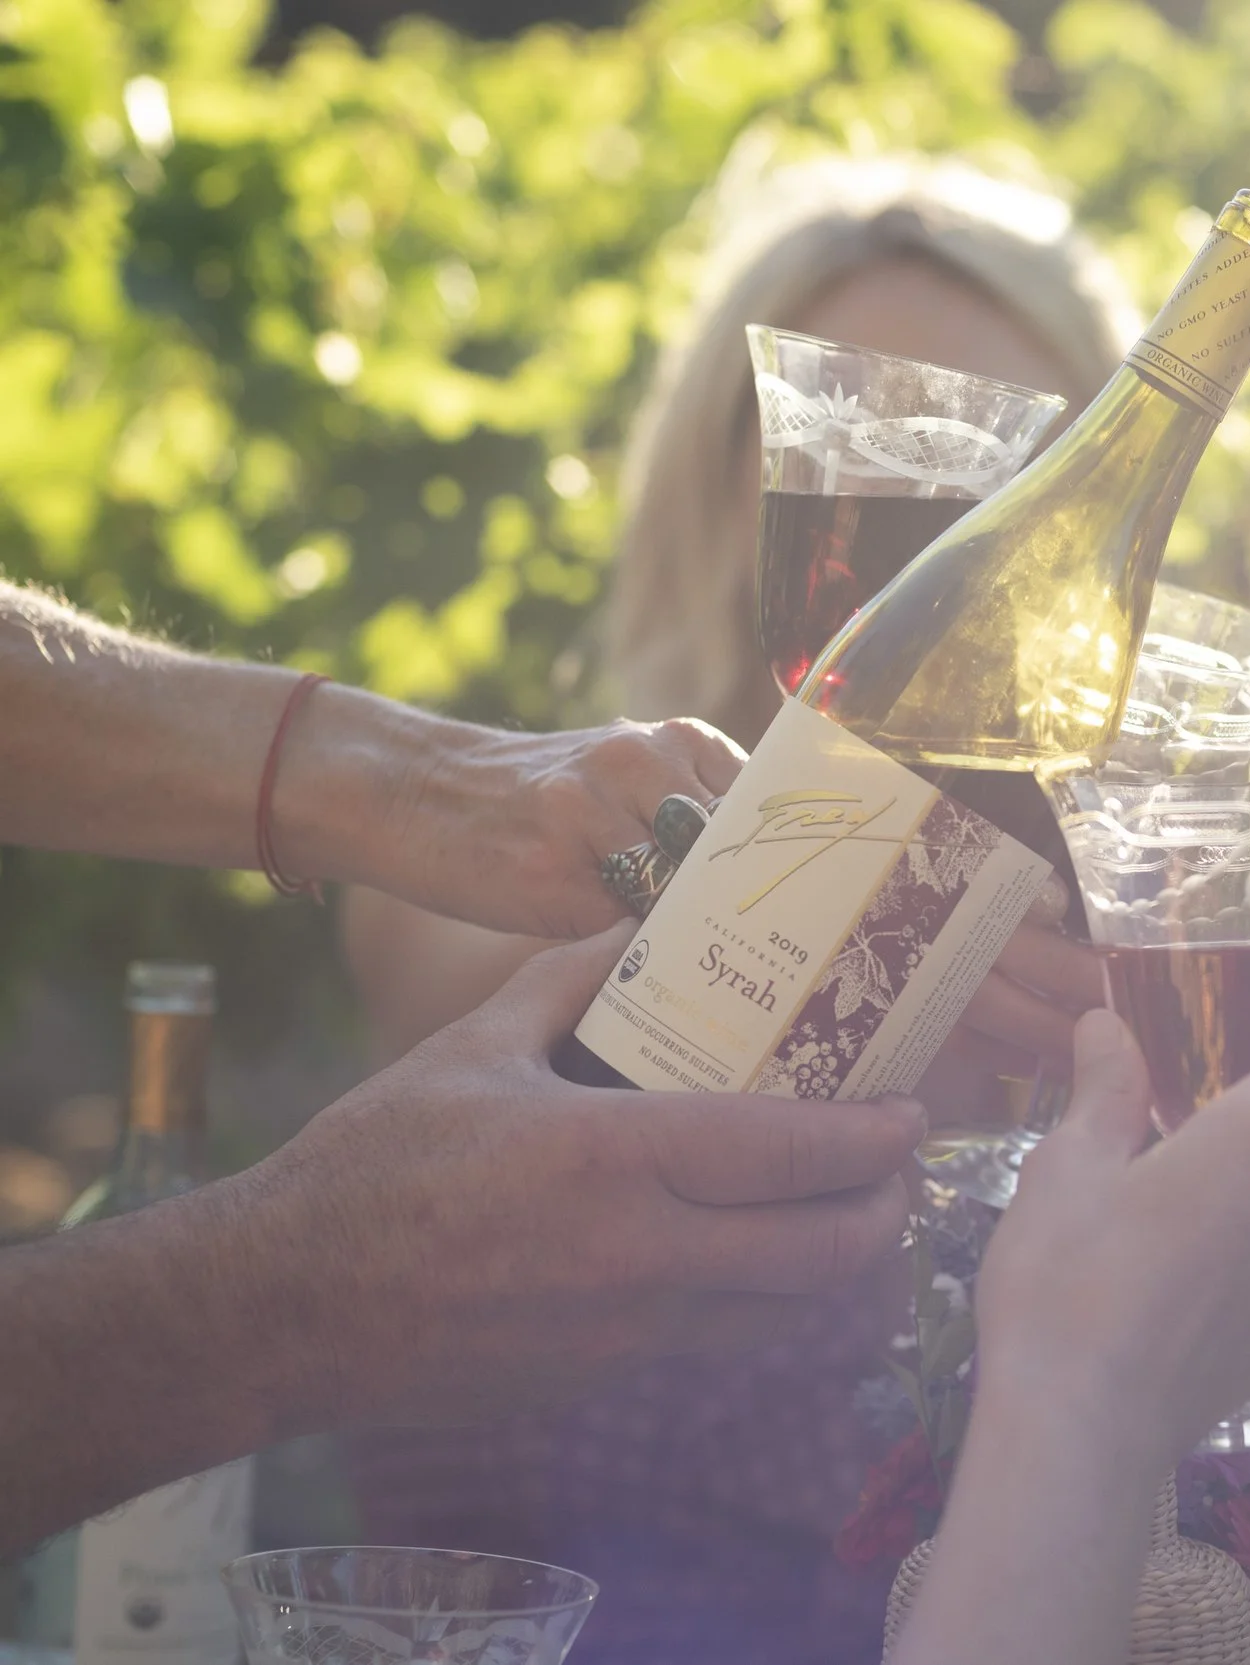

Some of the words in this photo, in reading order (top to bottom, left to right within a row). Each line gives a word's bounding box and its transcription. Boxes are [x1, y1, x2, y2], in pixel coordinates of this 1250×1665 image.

[1157, 328, 1174, 341] NO
[1179, 311, 1206, 330] GMO
[1210, 289, 1248, 314] YEAST
[1147, 350, 1201, 387] ORGANIC
[1191, 348, 1210, 362] NO
[705, 917, 795, 981] CALIFORNIA
[768, 931, 808, 965] 2019
[698, 943, 776, 1013] Syrah
[615, 1001, 647, 1029] NATURALLY
[644, 1025, 690, 1060] OCCURRING
[688, 1055, 730, 1087] SULFITES
[639, 1045, 652, 1058] NO
[650, 1053, 679, 1077] ADDED
[677, 1071, 714, 1093] SULFIT
